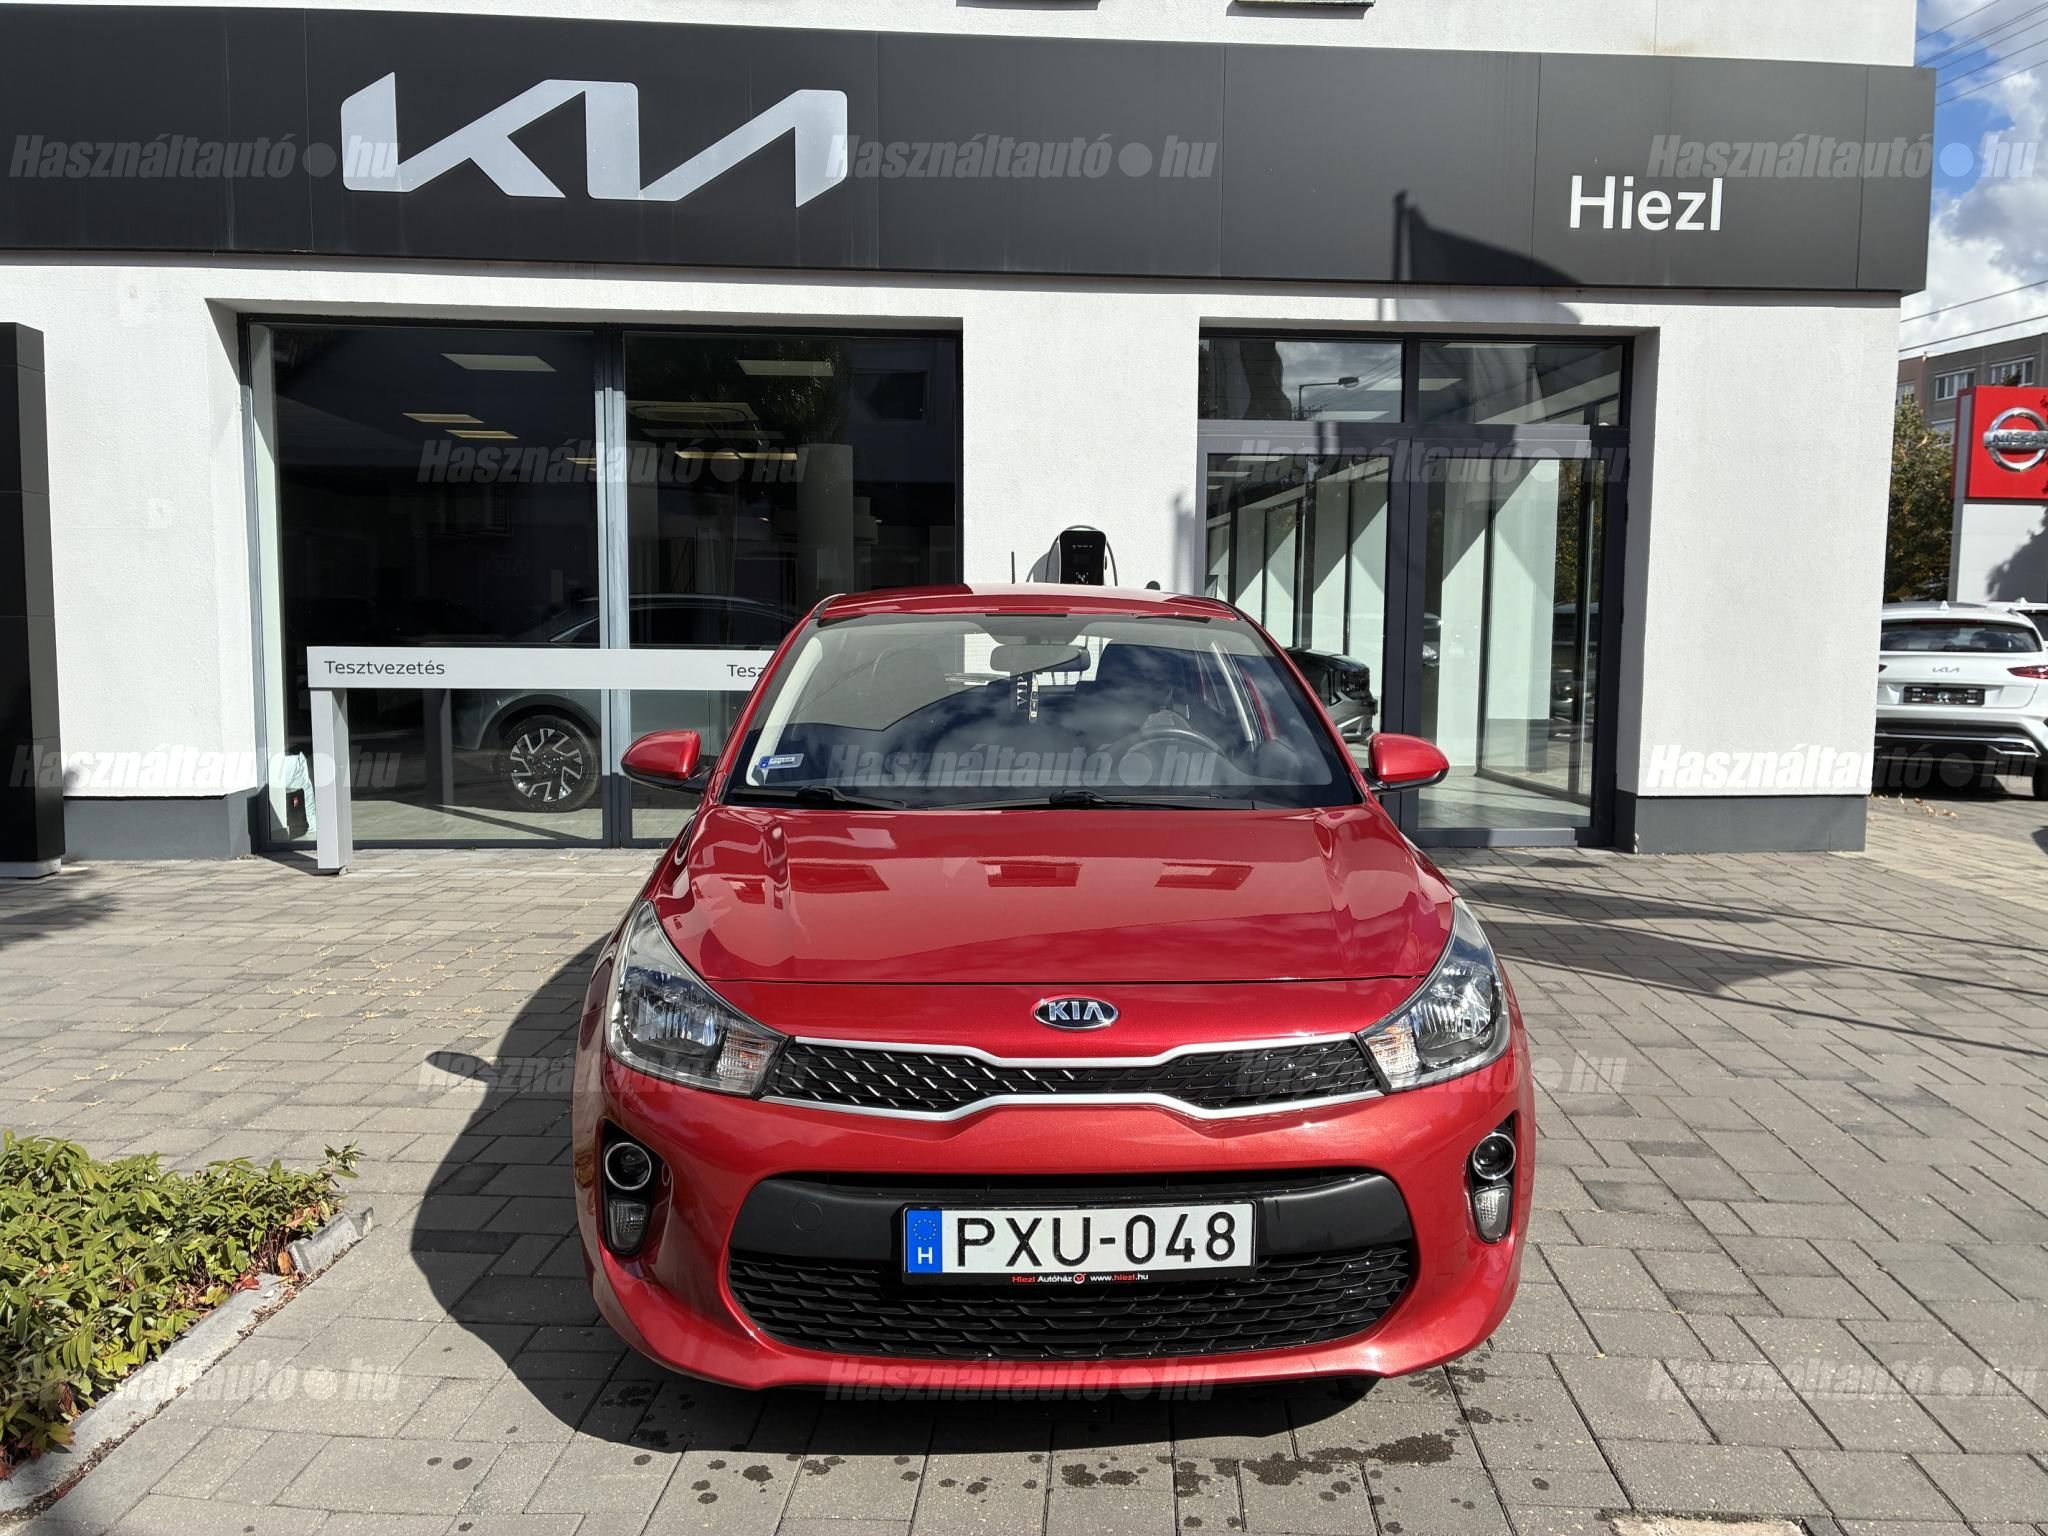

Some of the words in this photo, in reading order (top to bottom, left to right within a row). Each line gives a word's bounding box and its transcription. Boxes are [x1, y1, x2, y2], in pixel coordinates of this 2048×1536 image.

[1568, 175, 1724, 233] Hiezl
[324, 660, 446, 676] Tesztvezetés
[1048, 1001, 1105, 1021] KIA
[917, 1247, 933, 1264] H
[956, 1210, 1236, 1267] PXU-048
[1037, 1274, 1072, 1283] Autóház
[1090, 1273, 1149, 1283] www.hiezl.hu
